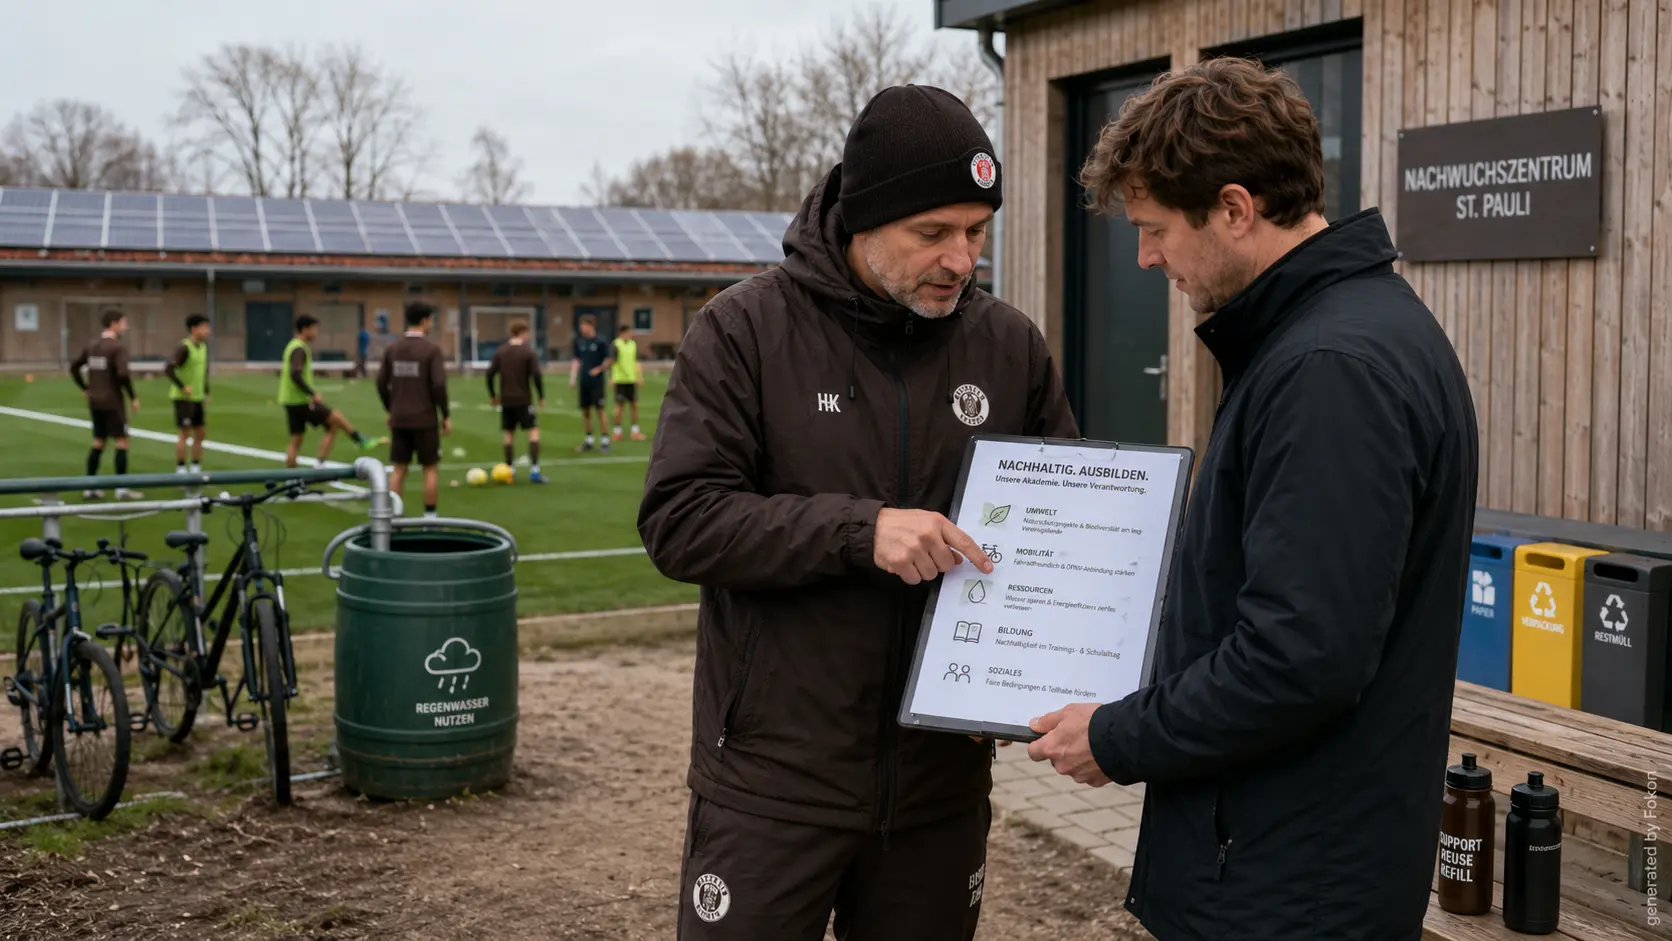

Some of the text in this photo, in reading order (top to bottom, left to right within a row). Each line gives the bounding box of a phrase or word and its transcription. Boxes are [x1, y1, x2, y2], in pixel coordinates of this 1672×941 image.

[1404, 152, 1592, 192] NACHWUCHSZENTRUM
[1456, 191, 1531, 219] ST. PAULI
[998, 459, 1149, 481] NACHHALTIG. AUSBILDEN.
[995, 475, 1147, 495] Unsere Akademie. Unsere Verantwortung.
[1025, 507, 1058, 516] UMWELT
[1016, 548, 1054, 558] MOBILITÄT
[1008, 584, 1054, 595] RESSOURCEN
[998, 626, 1033, 637] BILDUNG
[1594, 630, 1633, 648] RESTMÜLL
[988, 666, 1023, 677] SOZIALES
[415, 696, 490, 714] REGENWASSER
[434, 713, 475, 728] NUTZEN
[1441, 848, 1474, 867] REUSE
[1440, 862, 1474, 882] REFILL
